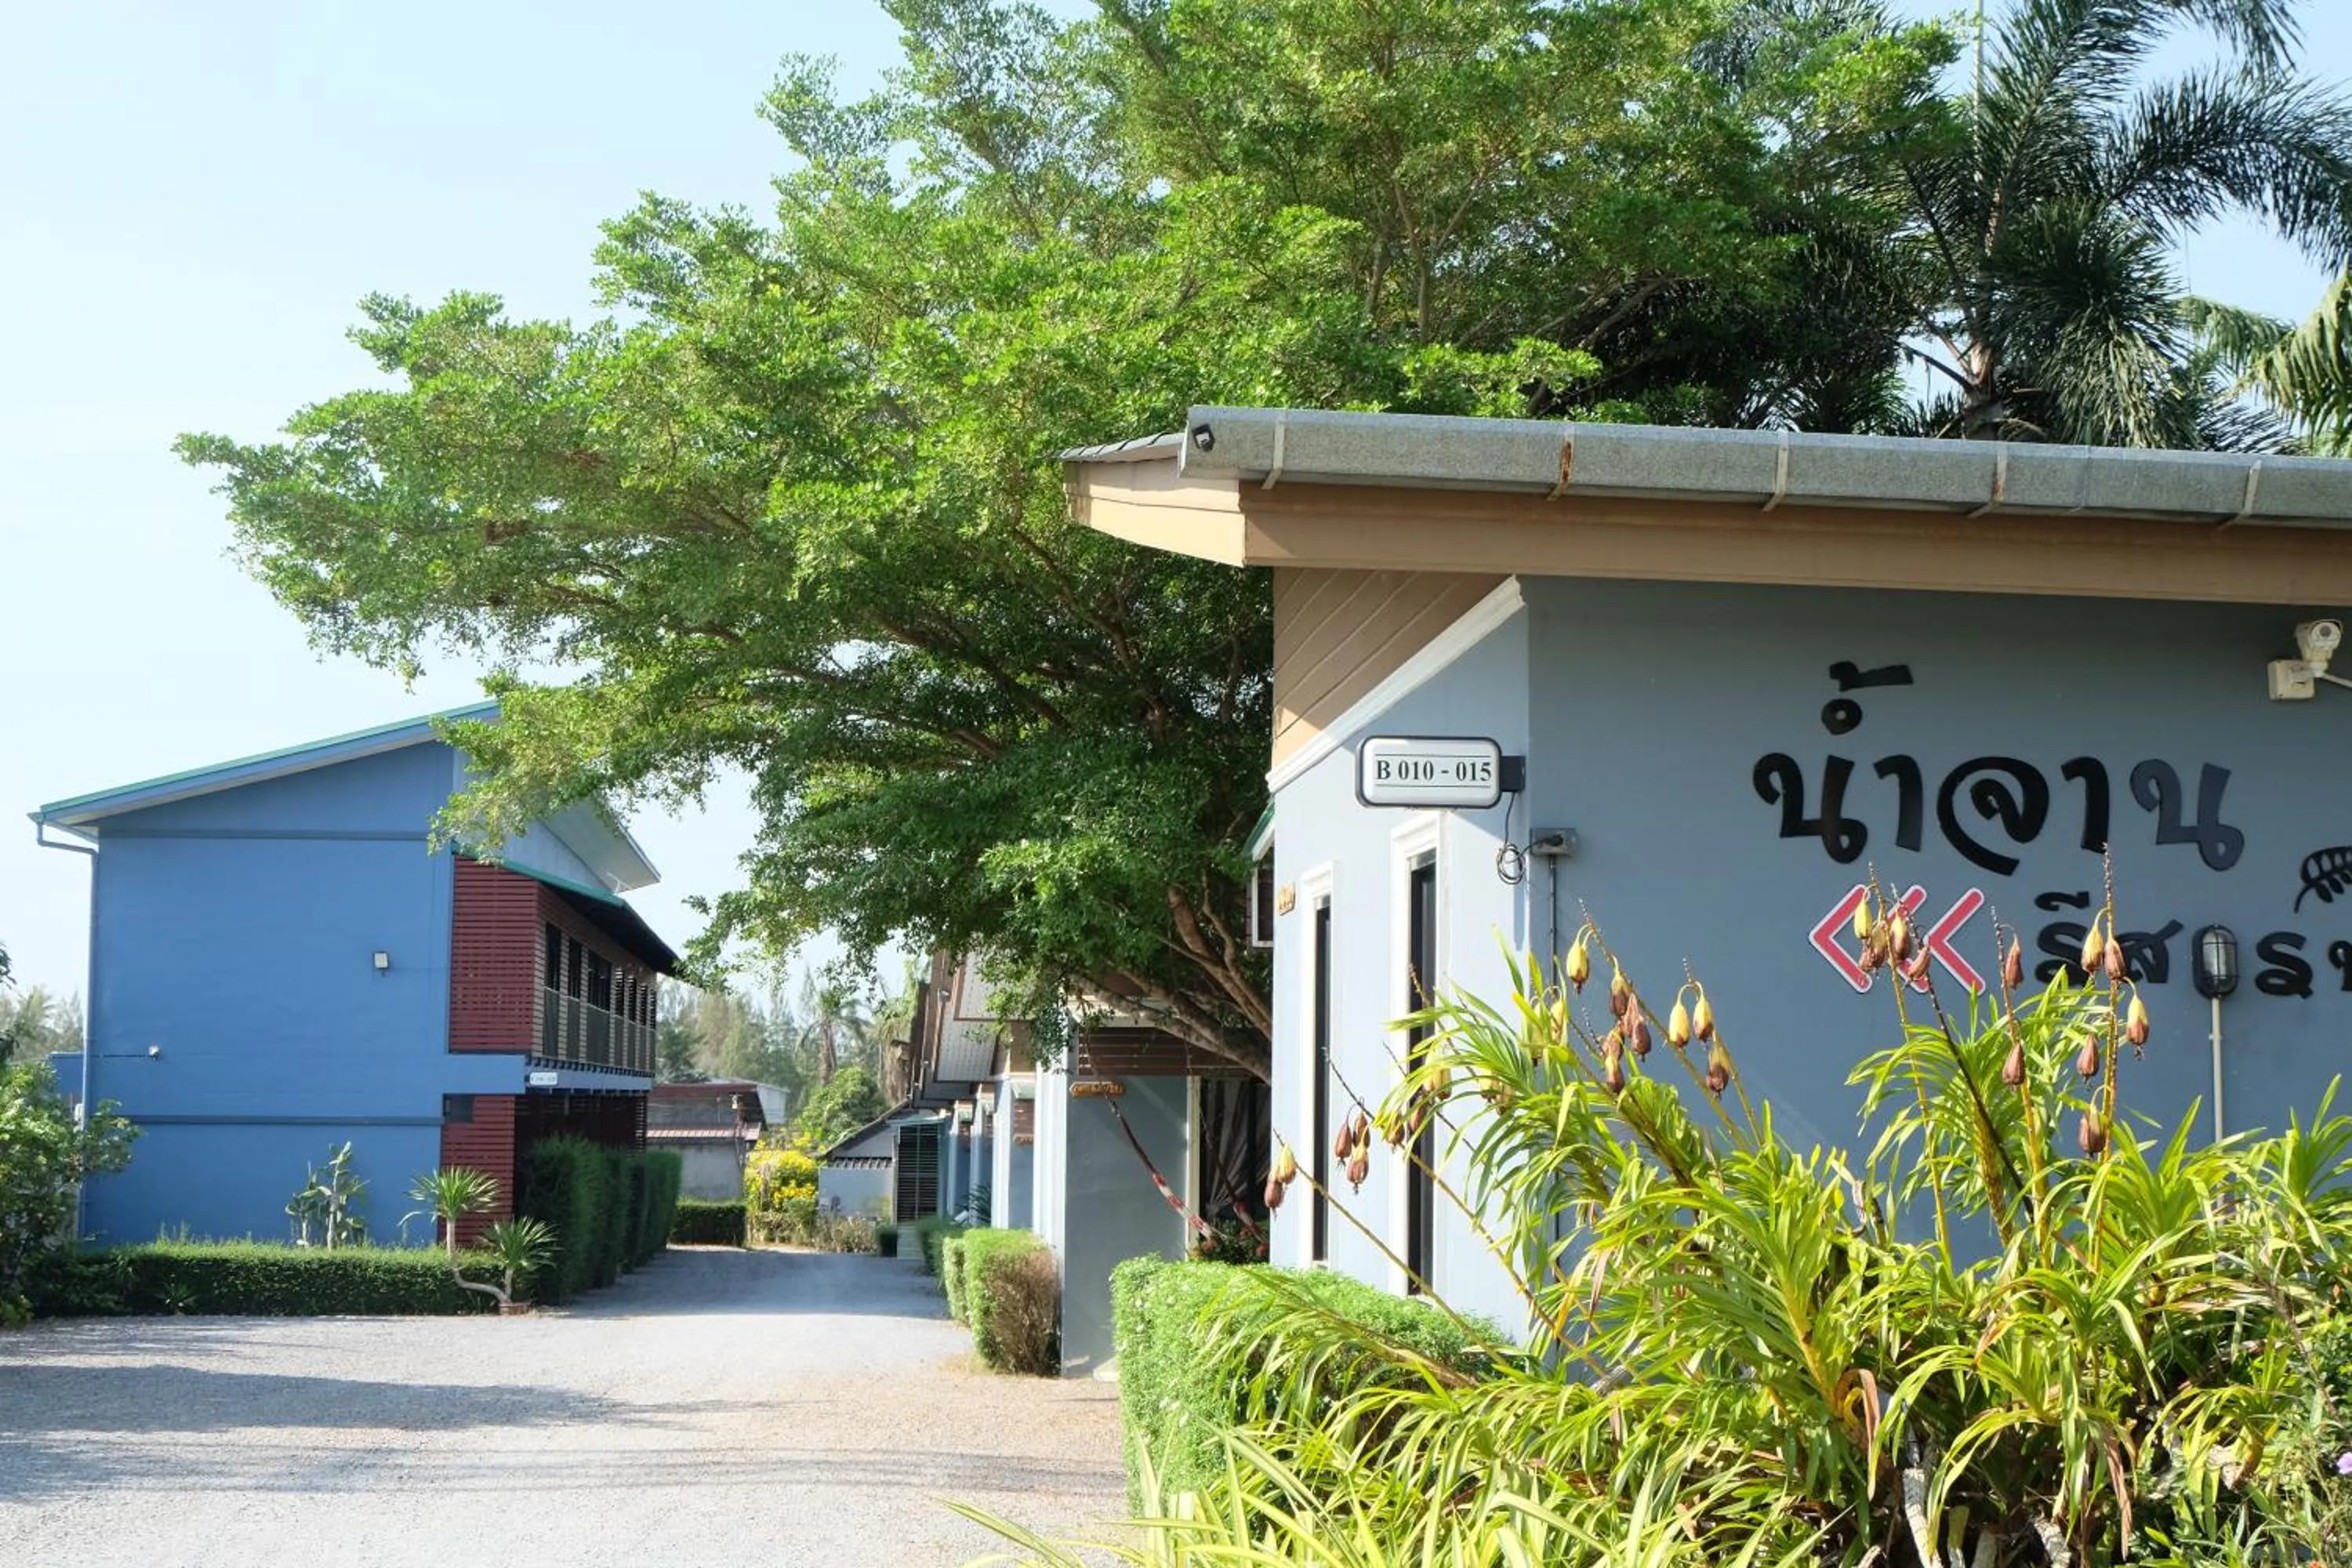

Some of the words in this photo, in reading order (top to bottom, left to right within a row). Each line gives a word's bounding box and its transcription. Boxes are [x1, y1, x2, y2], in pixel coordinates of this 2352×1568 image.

[1377, 760, 1391, 780] B
[1398, 760, 1434, 780] 010
[1456, 762, 1492, 782] 015
